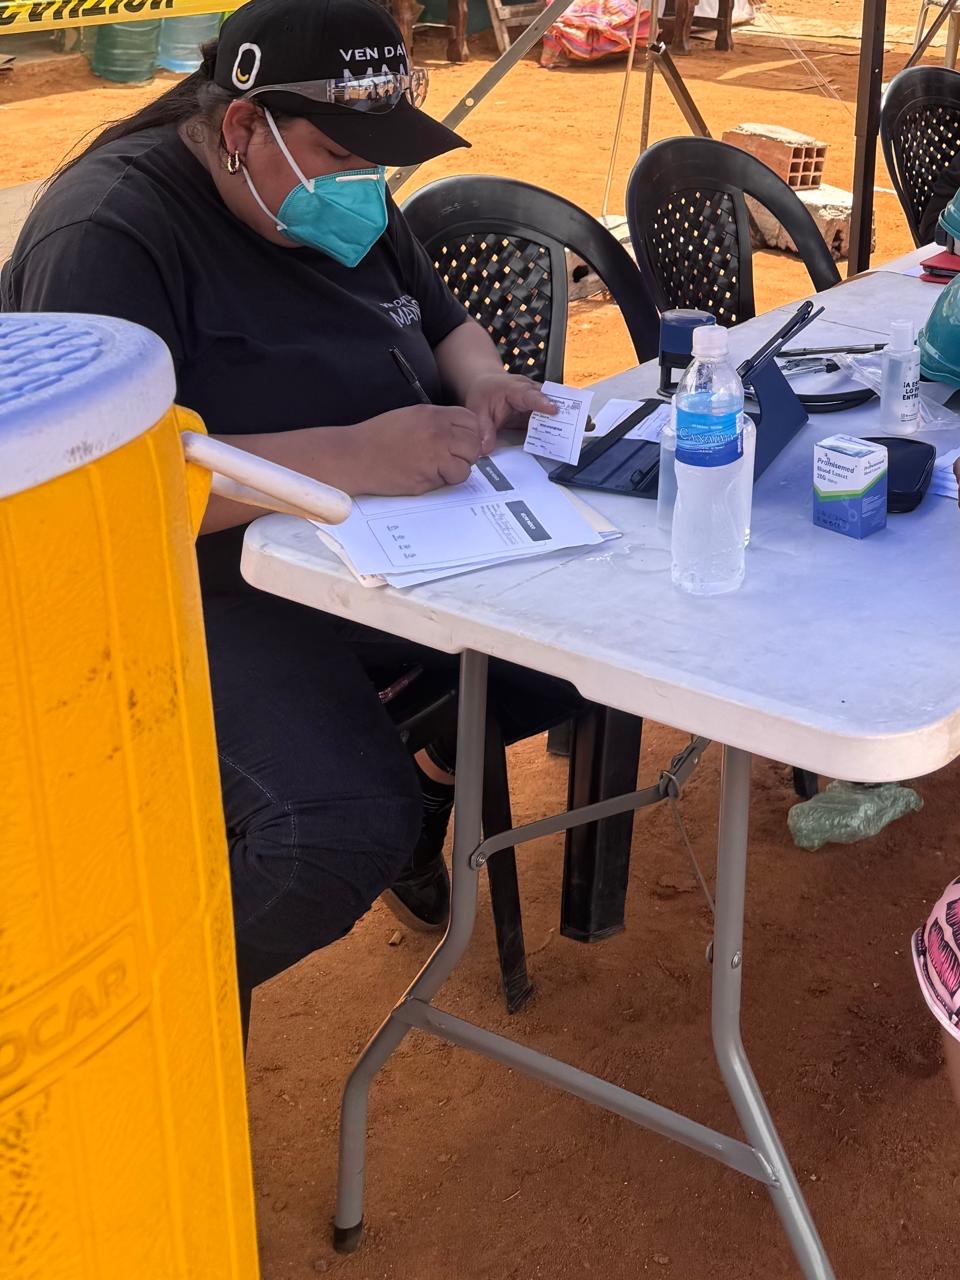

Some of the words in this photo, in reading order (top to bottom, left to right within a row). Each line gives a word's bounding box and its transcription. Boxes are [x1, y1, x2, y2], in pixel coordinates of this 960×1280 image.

[339, 47, 379, 61] VEN
[384, 41, 406, 59] DA
[816, 456, 855, 474] Promisemed
